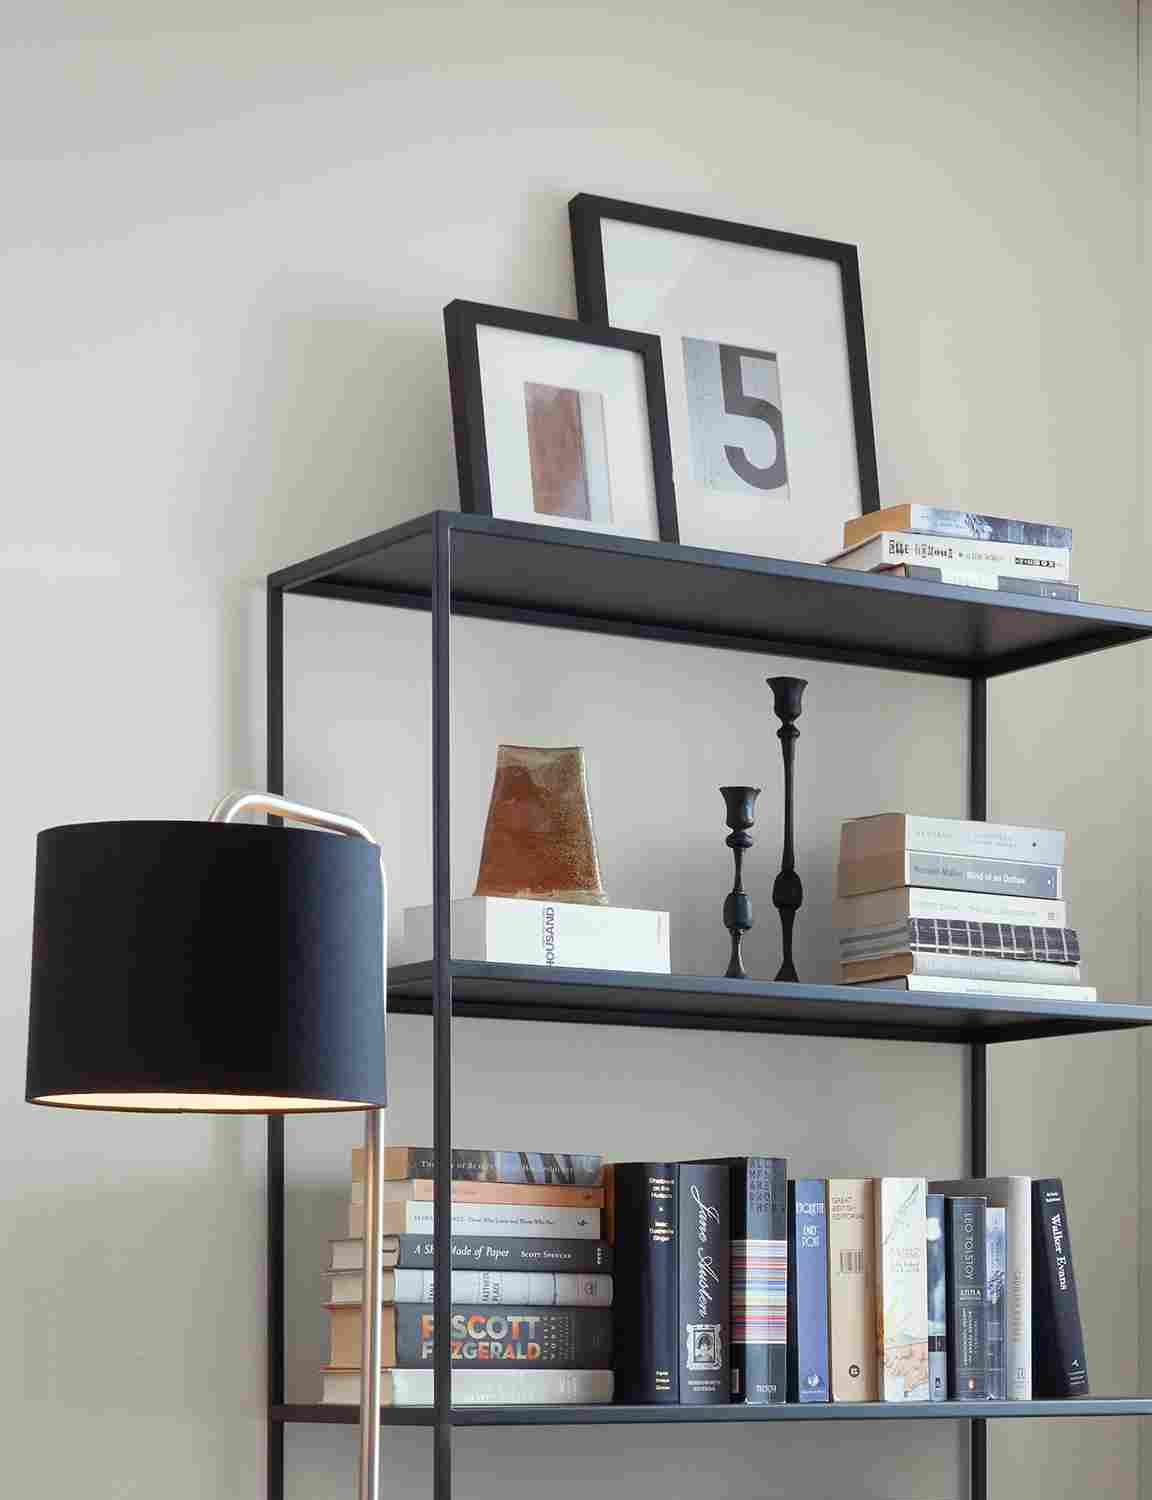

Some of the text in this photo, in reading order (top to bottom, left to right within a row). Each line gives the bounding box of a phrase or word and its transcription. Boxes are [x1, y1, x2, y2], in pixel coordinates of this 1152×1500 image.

[719, 343, 788, 490] 5
[545, 906, 555, 968] HOUSAND
[414, 1245, 422, 1256] A
[473, 1244, 485, 1260] of
[486, 1246, 511, 1260] Paper
[1050, 1213, 1063, 1255] Walker
[1056, 1254, 1067, 1290] Evans
[420, 1313, 434, 1338] F
[451, 1315, 541, 1340] SCOTT
[421, 1342, 541, 1360] FZGERALD
